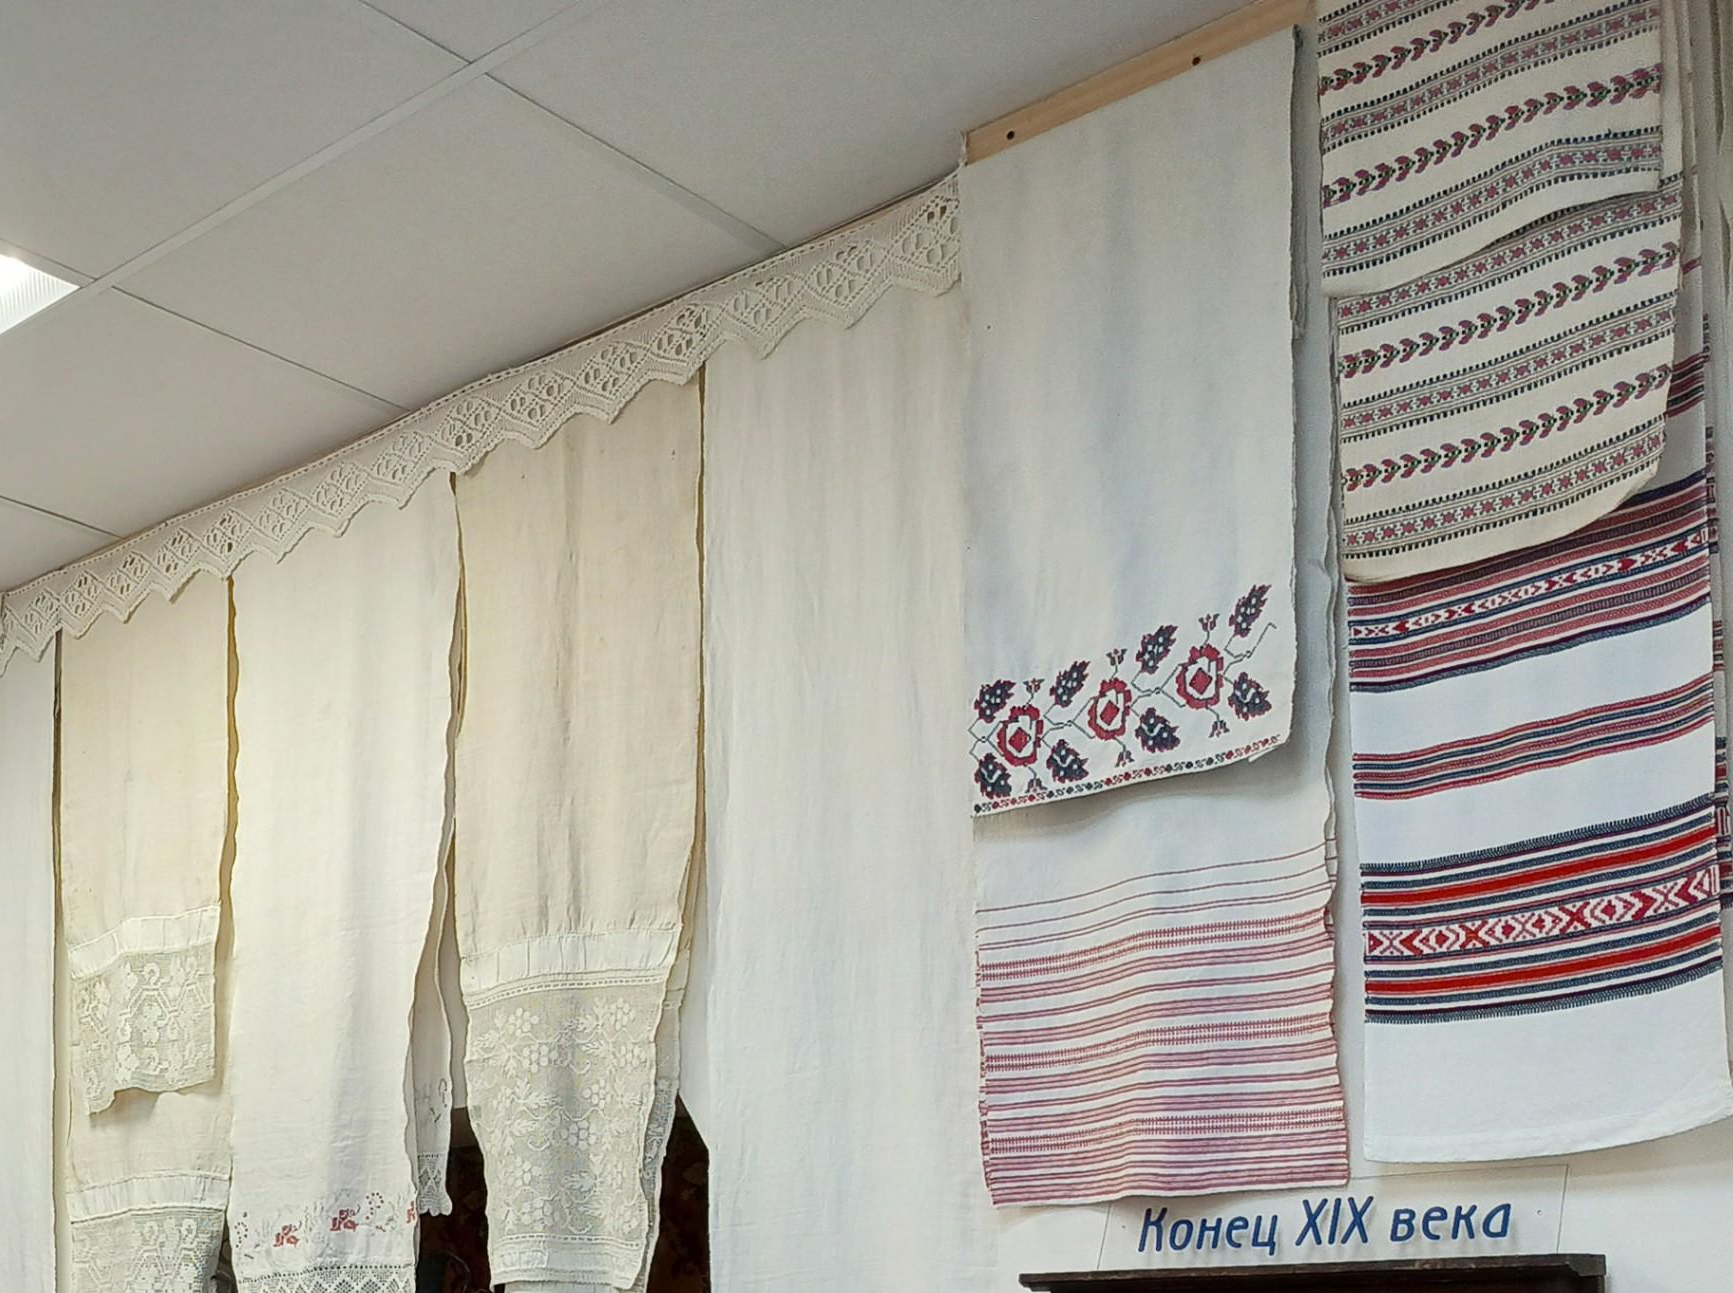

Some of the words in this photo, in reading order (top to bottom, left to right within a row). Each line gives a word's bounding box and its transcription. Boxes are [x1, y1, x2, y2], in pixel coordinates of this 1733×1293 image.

[1138, 1206, 1278, 1256] Конец
[1295, 1195, 1374, 1246] XIX
[1389, 1202, 1512, 1243] века
